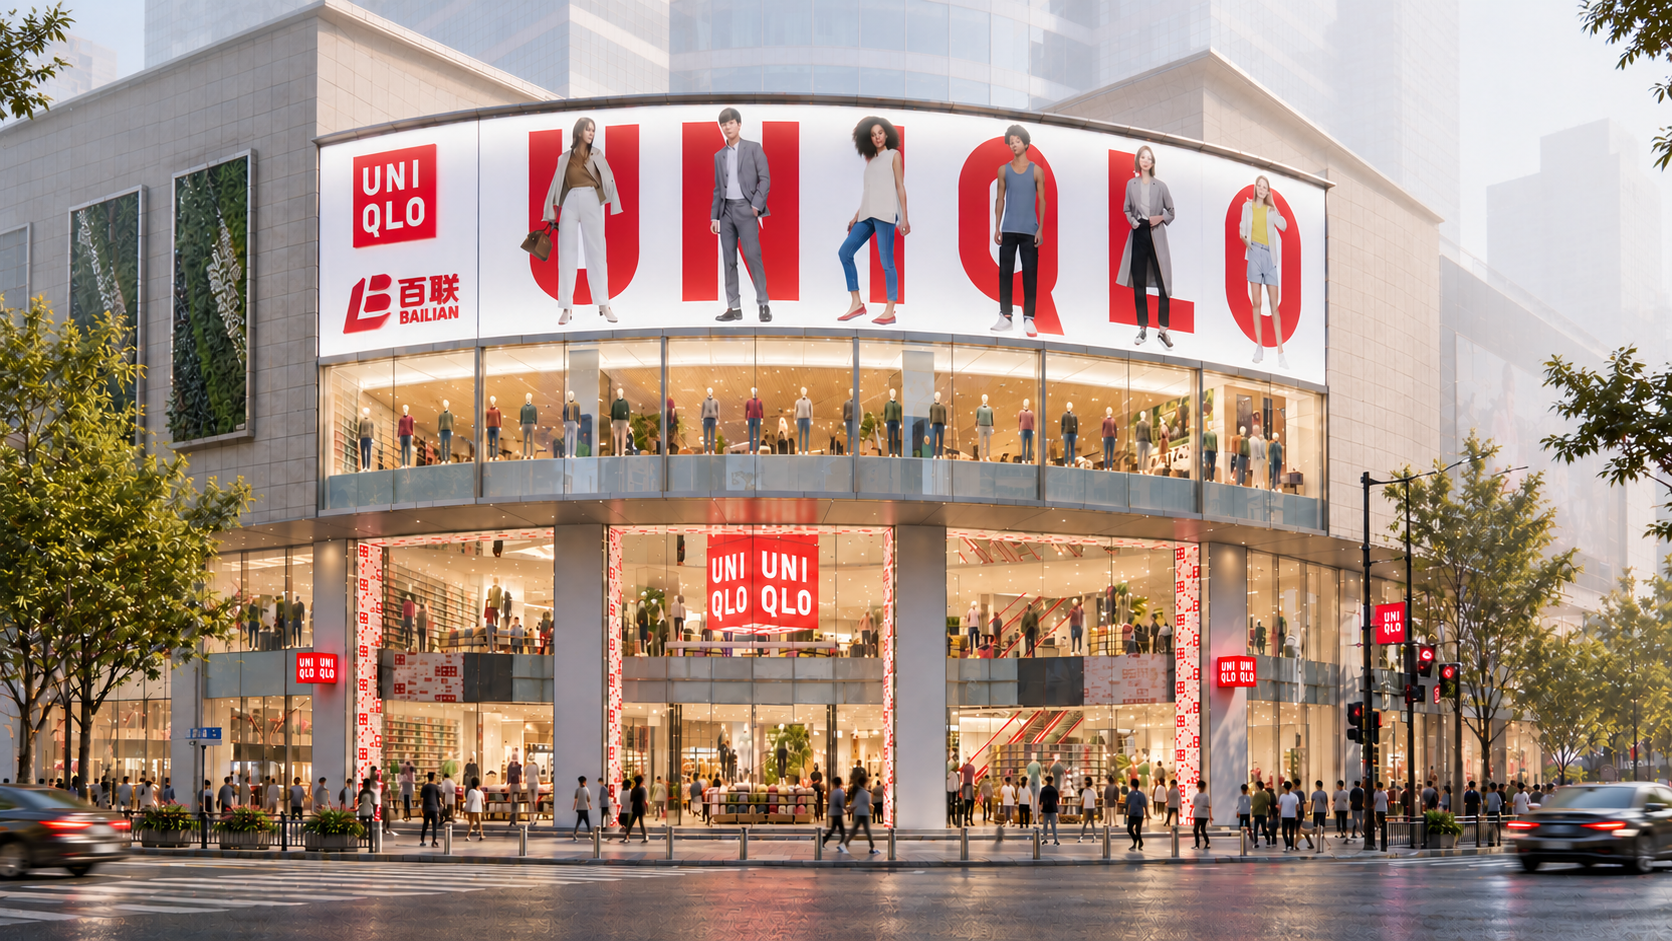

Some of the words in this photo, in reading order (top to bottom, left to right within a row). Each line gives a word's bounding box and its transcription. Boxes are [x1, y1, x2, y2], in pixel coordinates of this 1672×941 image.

[362, 159, 419, 196] UNI
[362, 196, 426, 238] QLO
[529, 121, 1302, 348] UNQLO
[398, 273, 460, 309] 百联
[399, 305, 459, 325] BAILIAN
[712, 552, 745, 583] UNI
[761, 550, 807, 583] UNI
[712, 586, 748, 621] QLO
[761, 585, 812, 618] QLO
[1384, 611, 1400, 622] UNI
[1384, 622, 1401, 635] QLO
[299, 657, 314, 668] UNI
[319, 657, 334, 668] UNI
[1221, 661, 1235, 671] UNI
[1240, 660, 1253, 671] UNI
[299, 668, 315, 680] QLO
[319, 668, 335, 680] QLO
[1221, 672, 1236, 684] QLO
[1240, 671, 1254, 683] QLO
